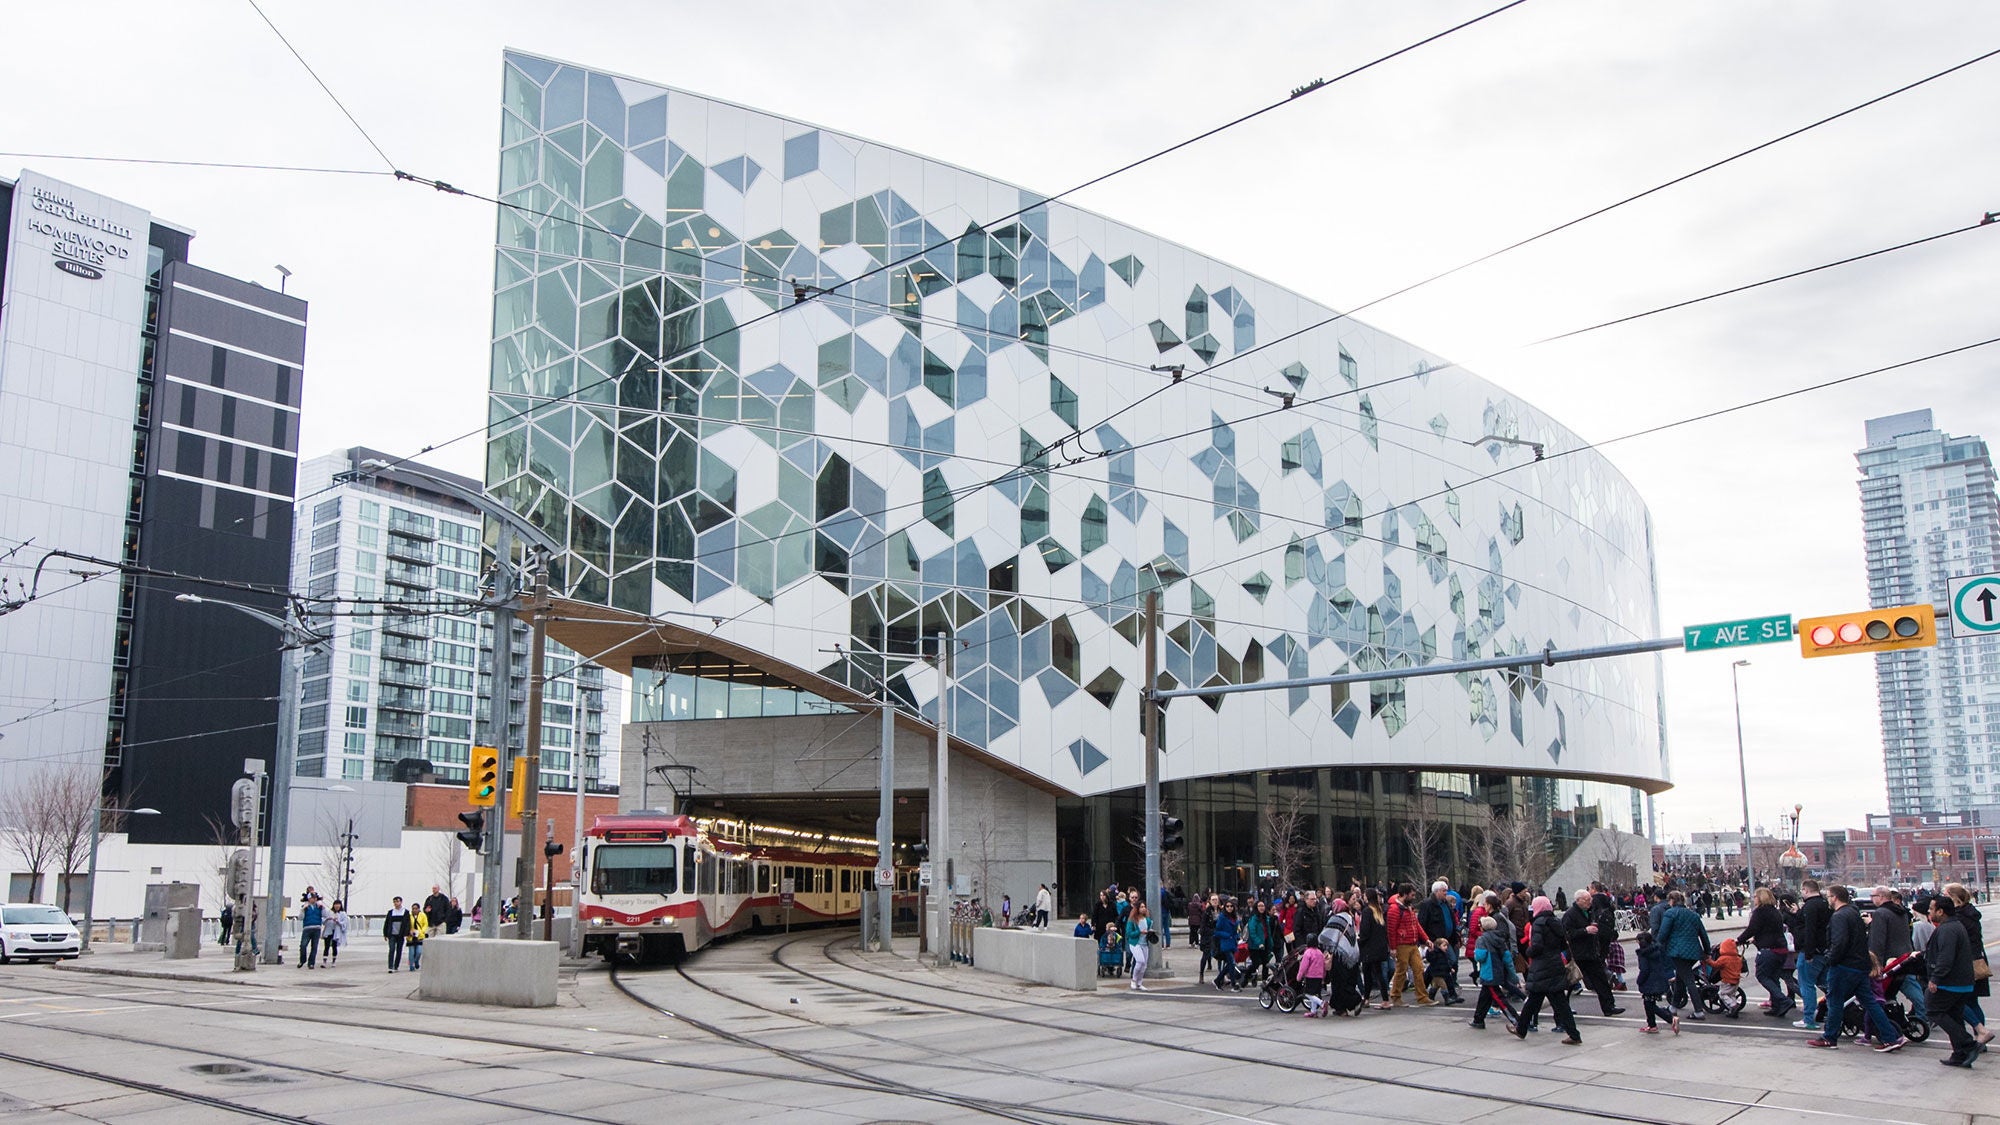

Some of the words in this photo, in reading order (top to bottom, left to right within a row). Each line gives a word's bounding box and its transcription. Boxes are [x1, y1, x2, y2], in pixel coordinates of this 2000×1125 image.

[33, 187, 75, 209] Hilton
[32, 198, 99, 230] Garden
[101, 218, 133, 241] Inn
[28, 218, 129, 260] HOMEWOOD
[53, 240, 105, 266] SUITES
[64, 261, 96, 278] Hilton
[1688, 629, 1702, 648] 7
[1714, 624, 1750, 645] AVE
[1761, 620, 1788, 639] SE
